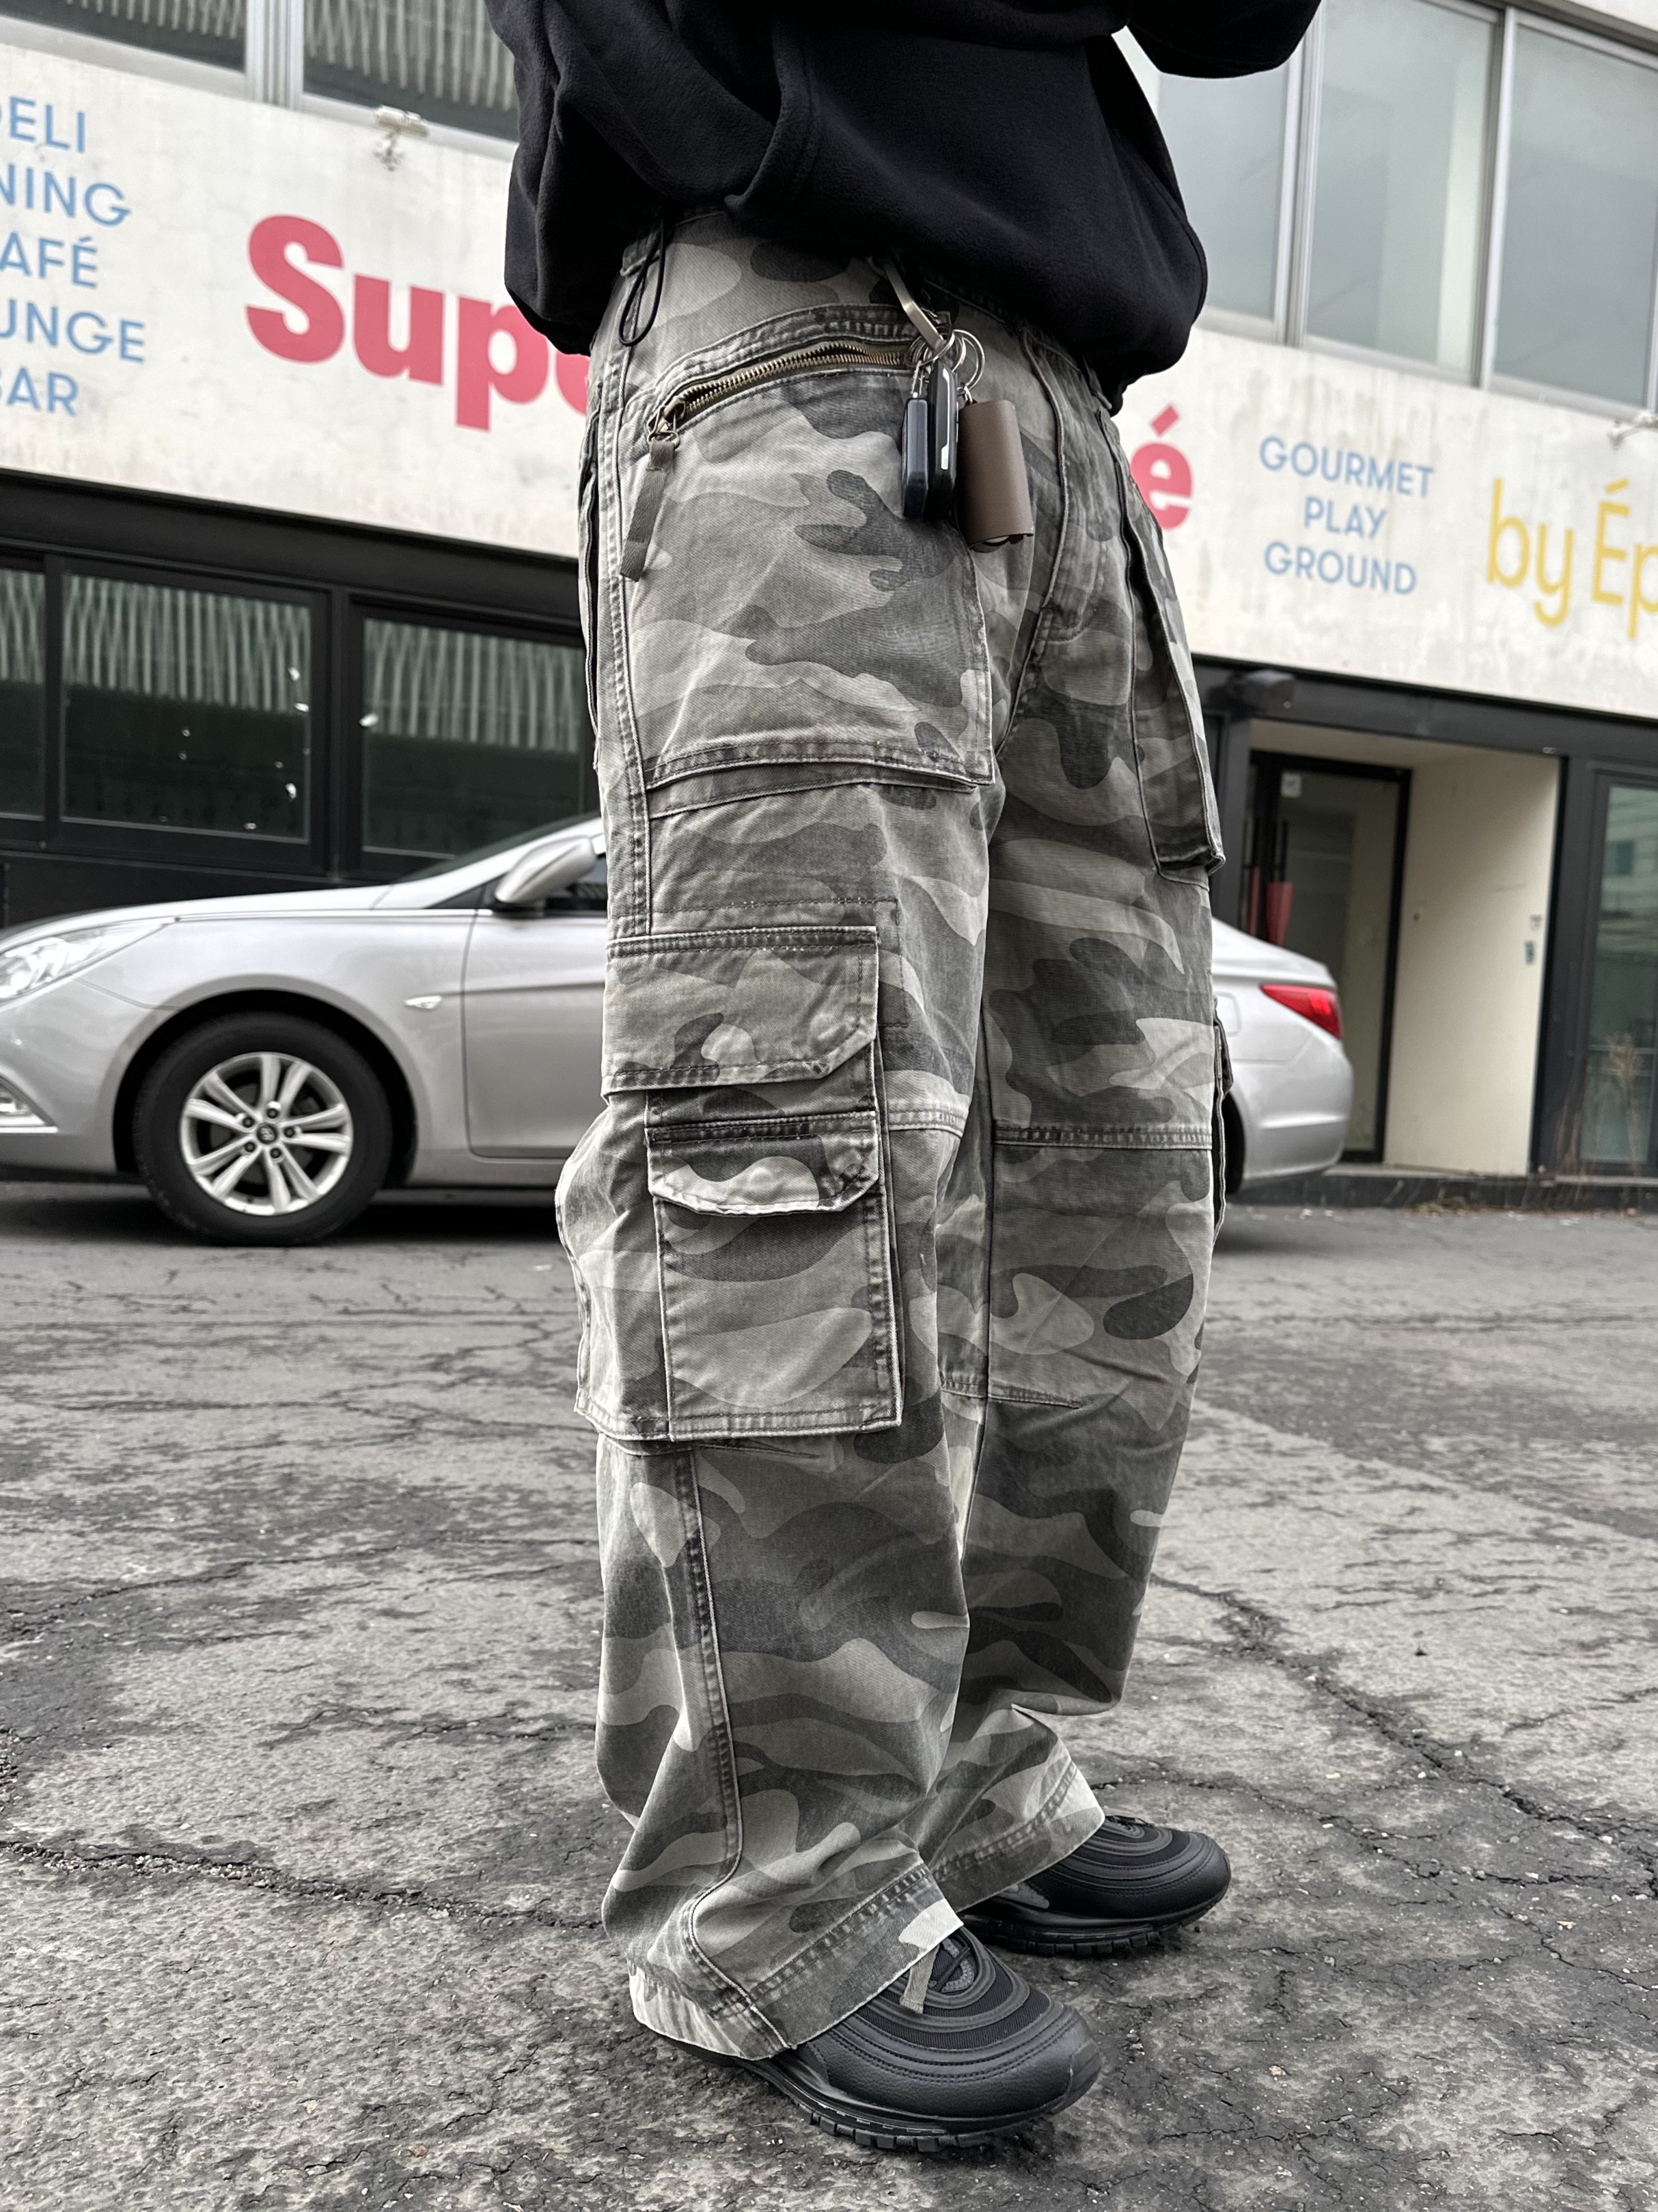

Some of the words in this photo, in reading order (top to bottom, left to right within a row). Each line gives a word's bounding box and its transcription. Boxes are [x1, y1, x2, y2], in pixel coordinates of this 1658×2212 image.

[0, 95, 86, 154] ELI
[245, 213, 591, 433] Sup
[0, 366, 80, 416] AR
[1258, 436, 1434, 498] GOURMET
[1303, 496, 1387, 538] PLAY
[1263, 541, 1418, 595] GROUND
[1486, 477, 1575, 628] by
